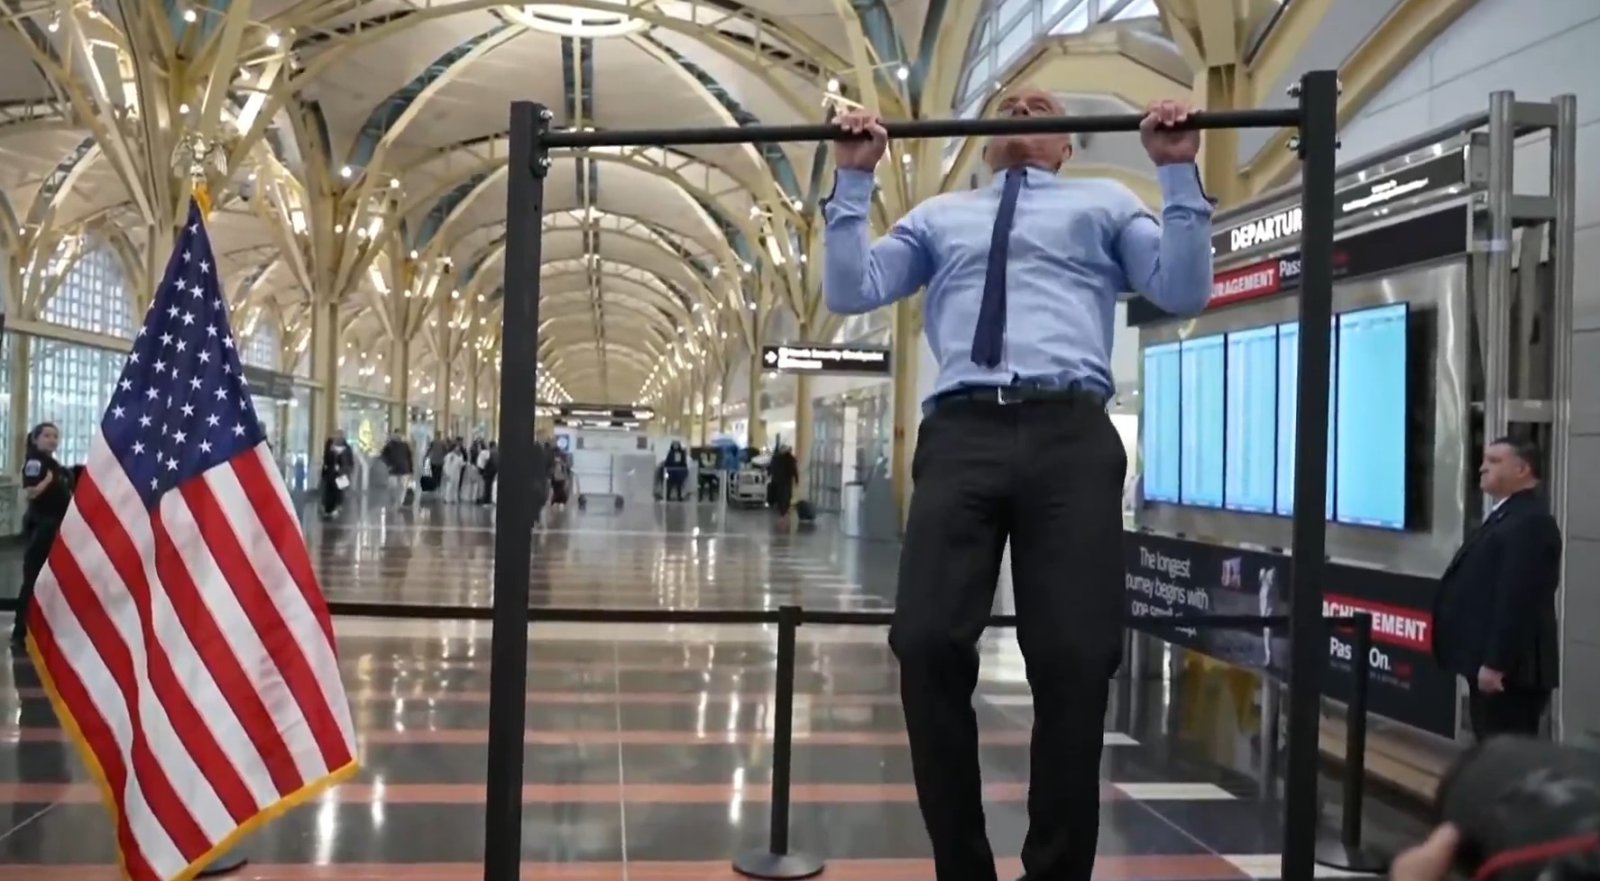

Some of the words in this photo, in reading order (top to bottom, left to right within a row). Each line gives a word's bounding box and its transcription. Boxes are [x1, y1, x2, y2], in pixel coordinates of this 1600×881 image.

[1231, 208, 1302, 251] DEPARTUR
[1212, 269, 1274, 297] URAGEMENT
[1140, 546, 1156, 569] The
[1157, 551, 1190, 578] longest
[1155, 577, 1186, 605] begins
[1187, 587, 1209, 610] with
[1322, 600, 1427, 641] ACHIEMENT
[1330, 636, 1352, 660] Pas
[1369, 647, 1391, 671] On.
